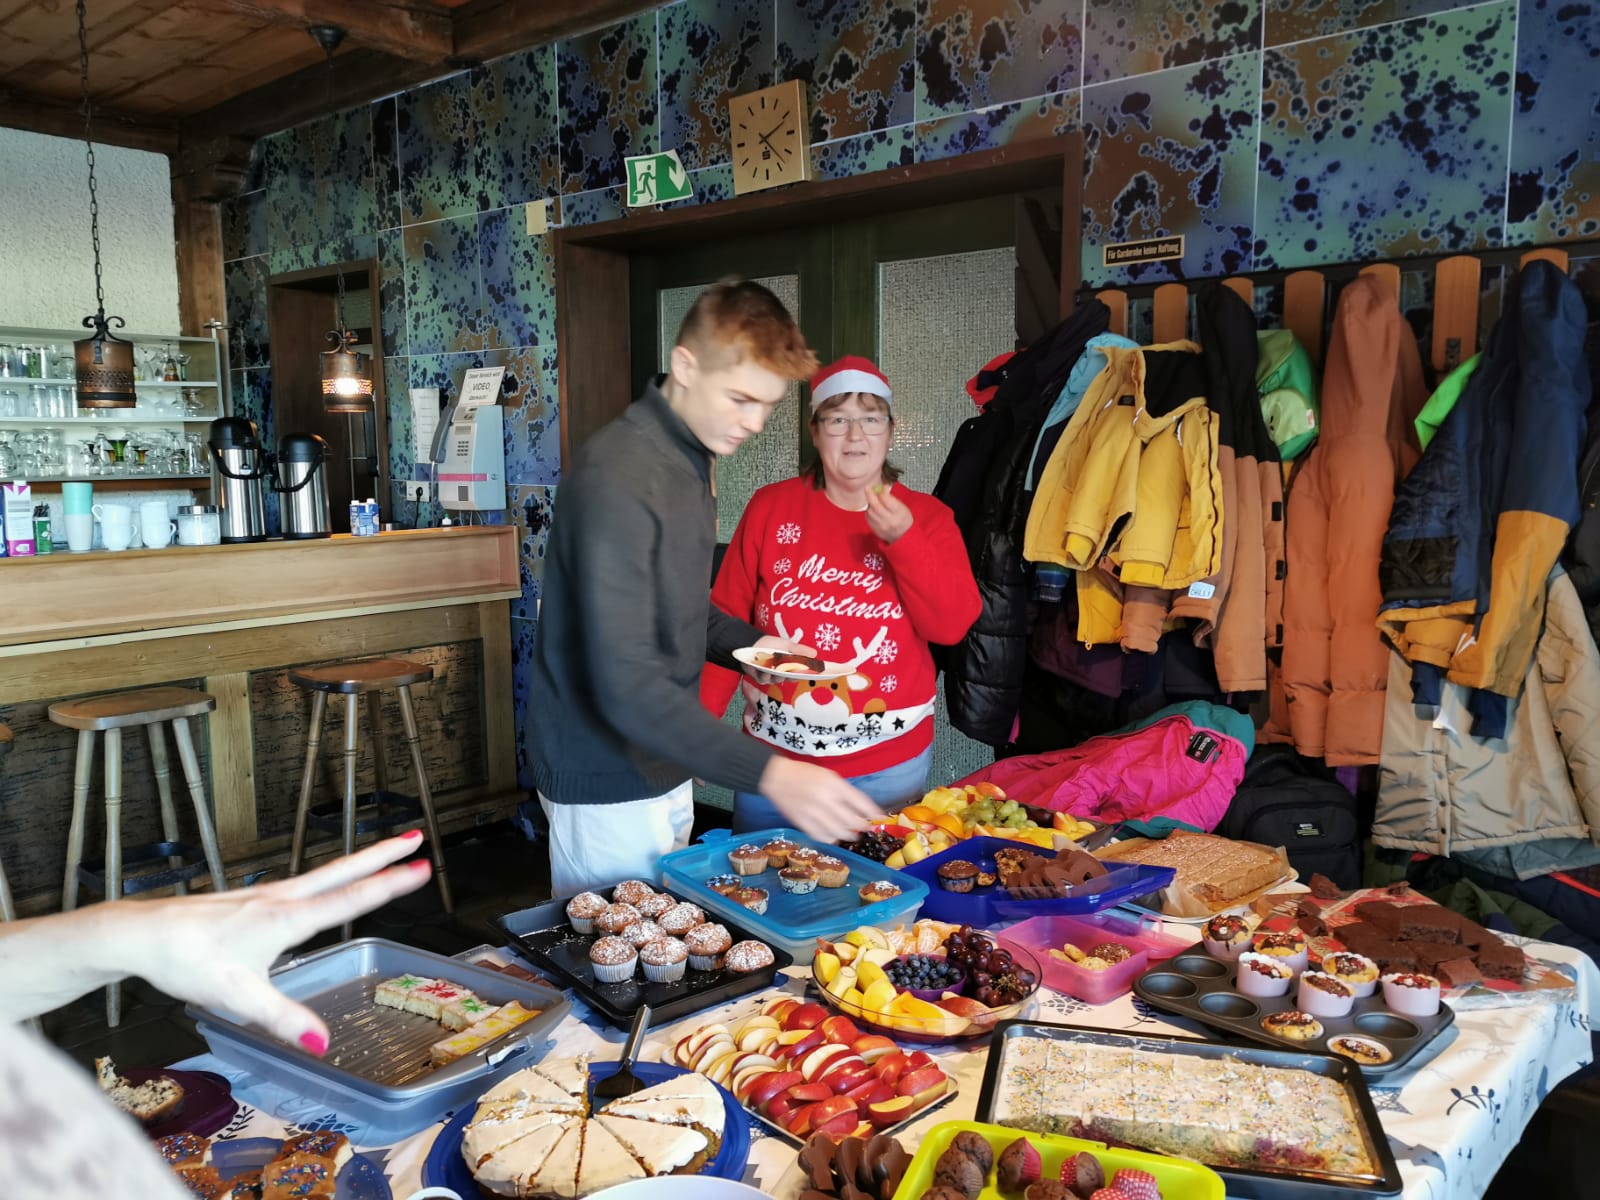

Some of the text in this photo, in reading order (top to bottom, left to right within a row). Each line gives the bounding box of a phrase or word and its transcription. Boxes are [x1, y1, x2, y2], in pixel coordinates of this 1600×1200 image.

[473, 382, 490, 391] VIDEO
[797, 553, 883, 594] Merry
[770, 577, 905, 620] Christmas
